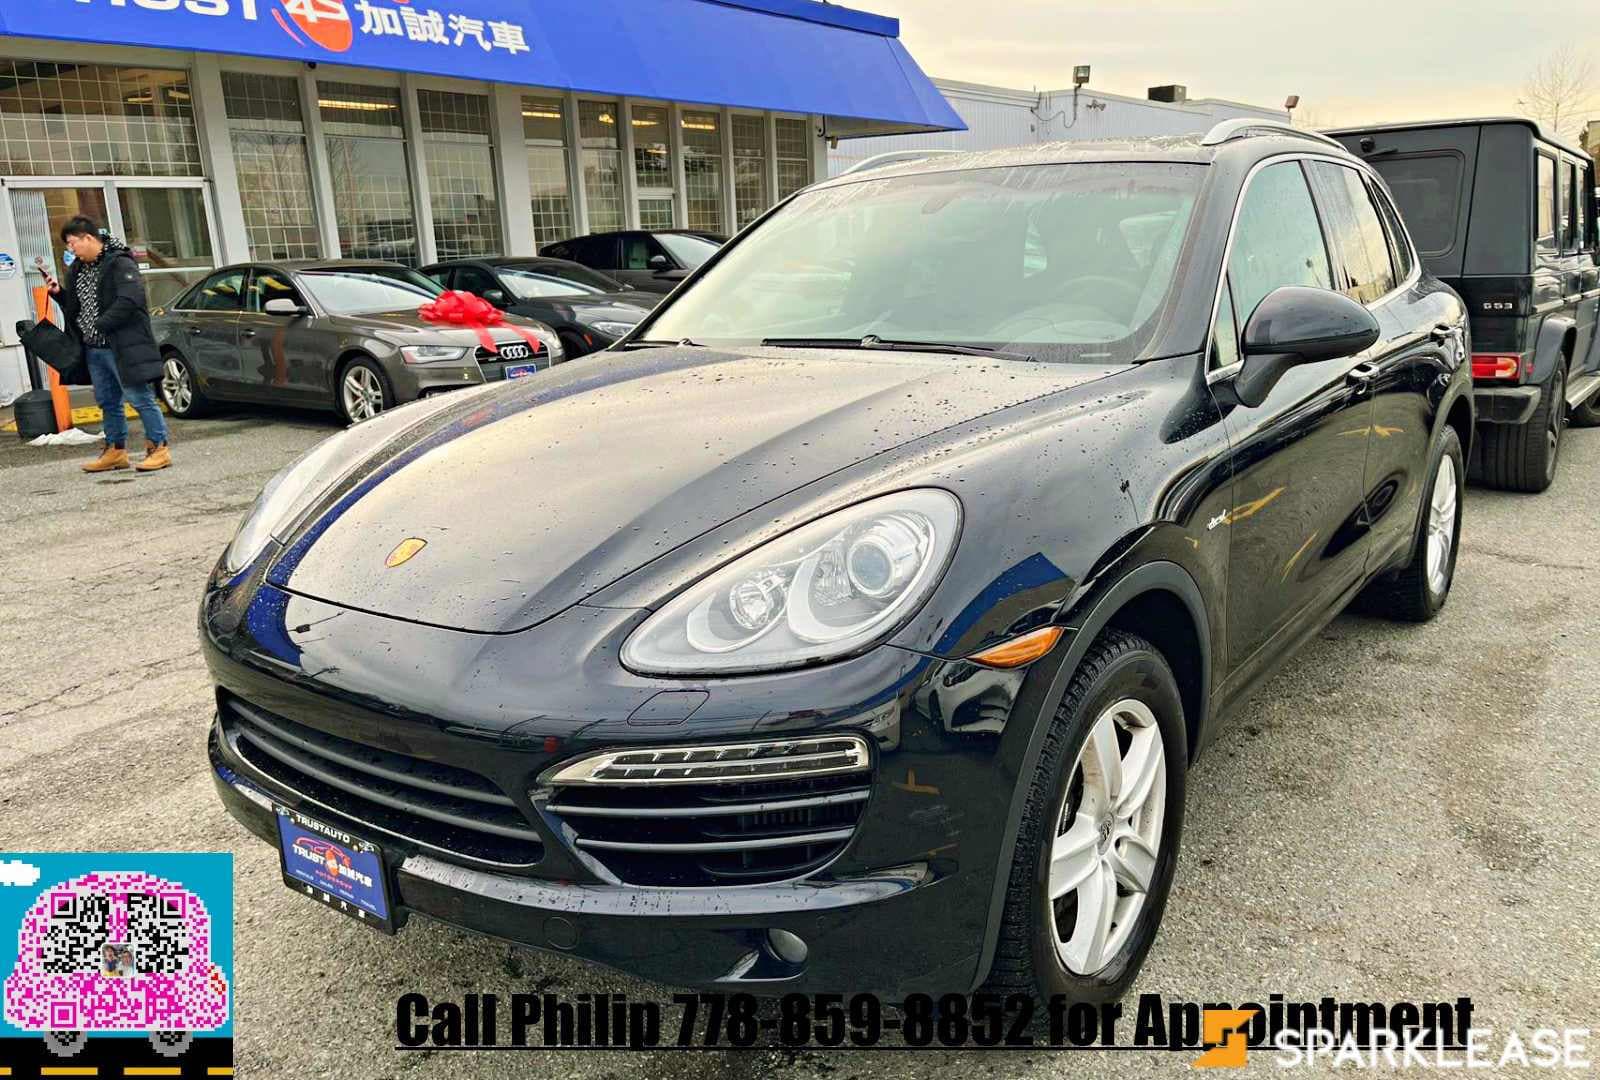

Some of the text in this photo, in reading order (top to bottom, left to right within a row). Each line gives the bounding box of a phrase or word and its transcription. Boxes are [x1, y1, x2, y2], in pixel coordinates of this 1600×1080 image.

[354, 0, 531, 54] 加誠汽車
[295, 814, 350, 843] TRUSTAUTO
[292, 844, 326, 865] TRUST
